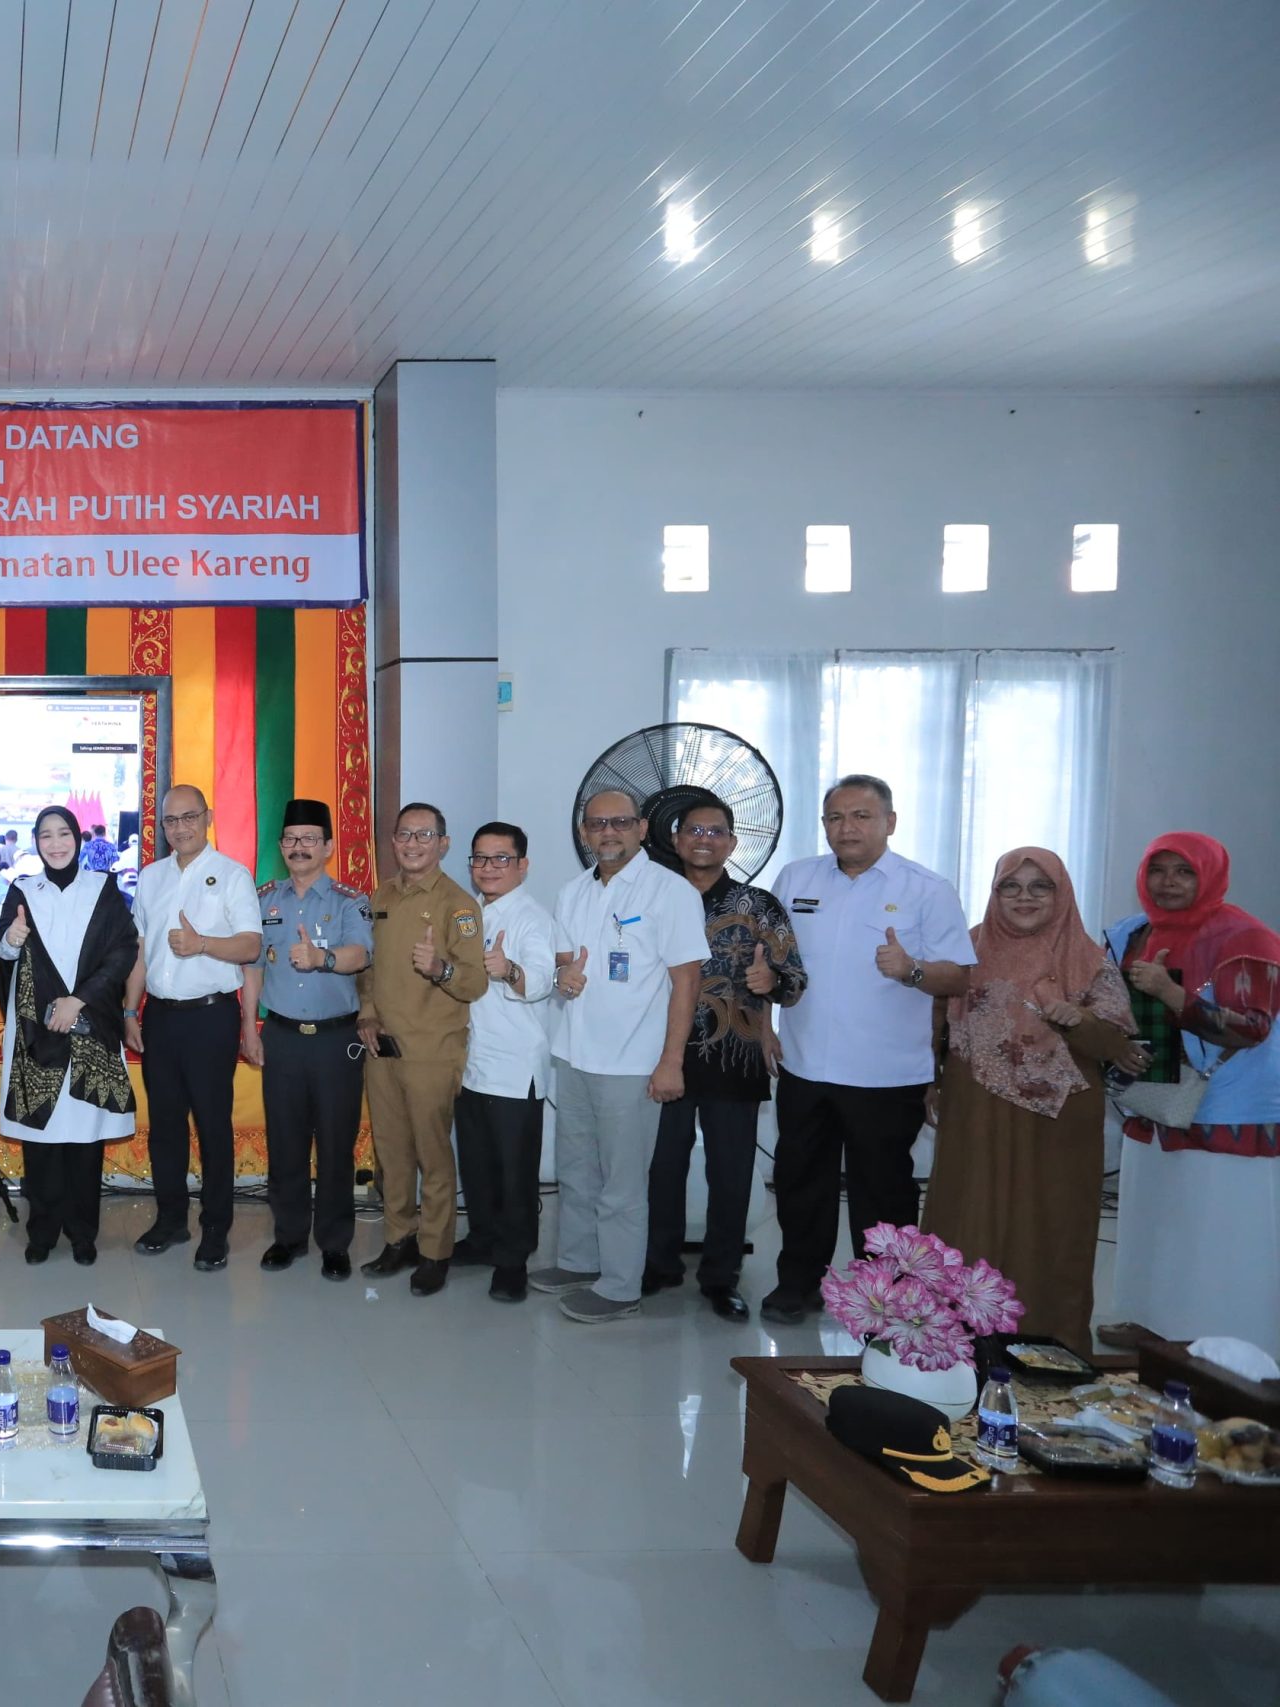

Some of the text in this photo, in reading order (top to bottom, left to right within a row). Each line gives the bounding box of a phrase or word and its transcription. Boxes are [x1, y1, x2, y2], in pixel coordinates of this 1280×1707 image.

[5, 423, 139, 450] DATANG
[69, 495, 166, 521] PUTIH
[177, 494, 320, 520] SYARIAH
[106, 549, 180, 577] Ulee
[190, 549, 311, 583] Kareng
